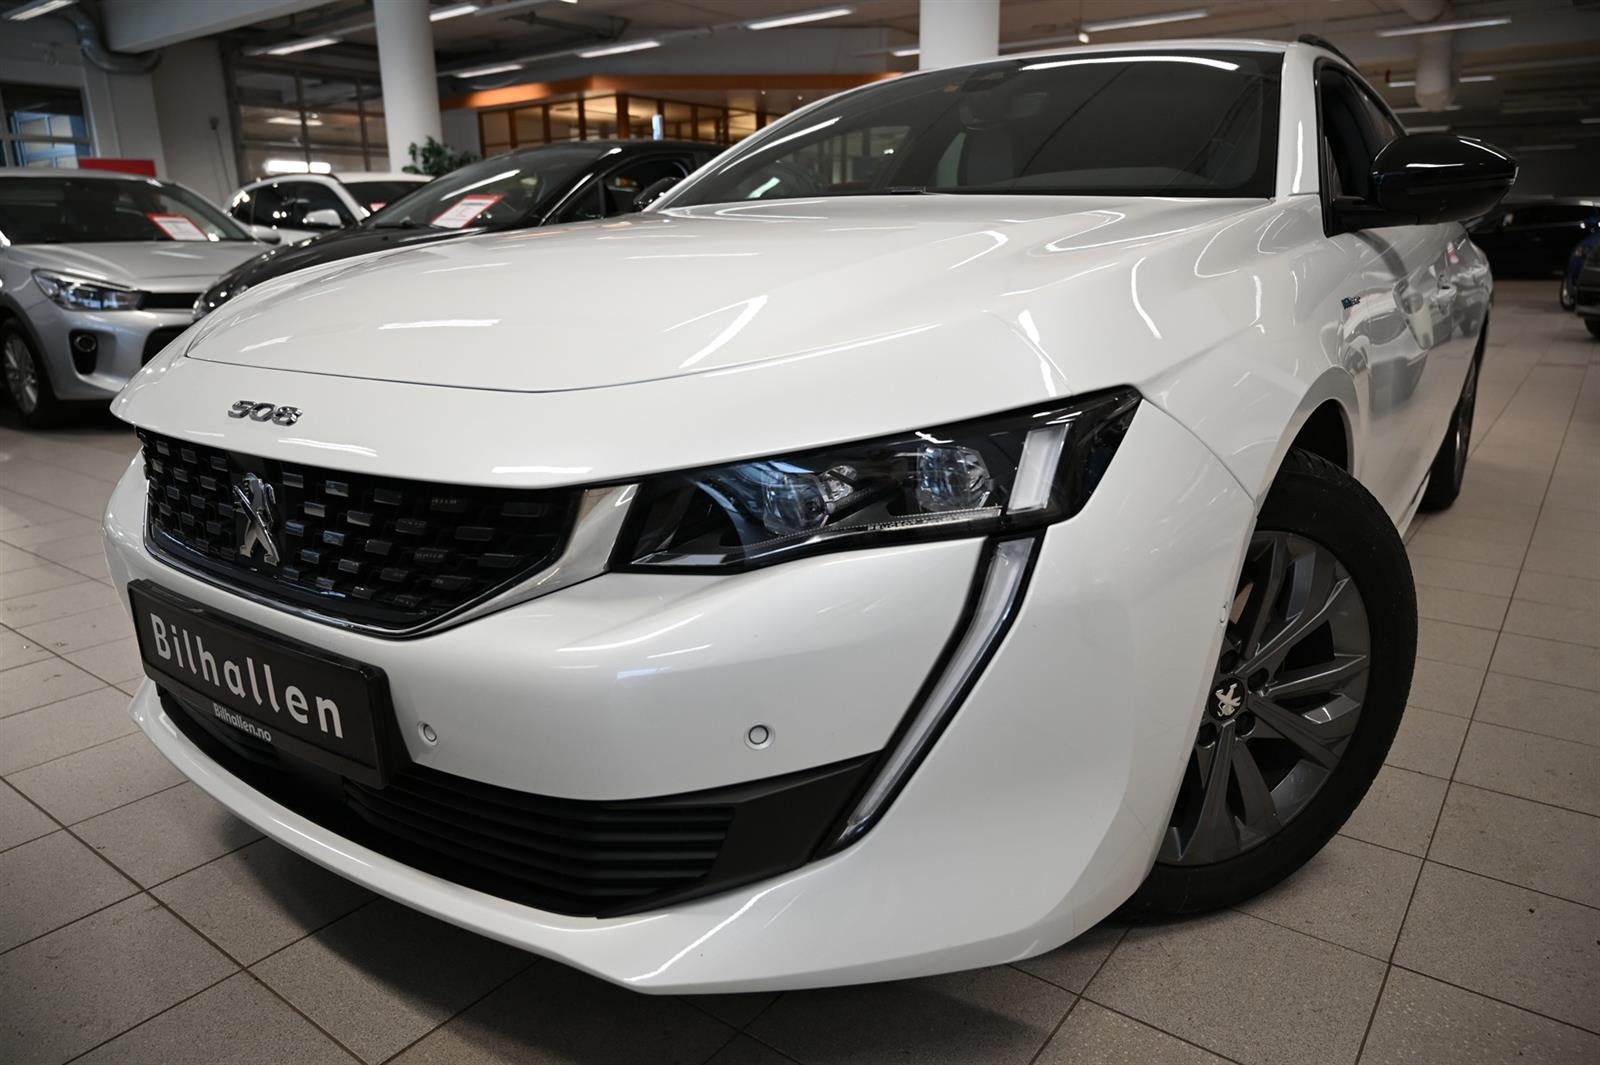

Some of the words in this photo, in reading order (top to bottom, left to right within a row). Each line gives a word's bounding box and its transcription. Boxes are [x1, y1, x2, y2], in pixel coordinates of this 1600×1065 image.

[228, 400, 303, 426] 508
[150, 612, 344, 739] Bilhallen
[213, 703, 272, 743] Bilhallen.no
